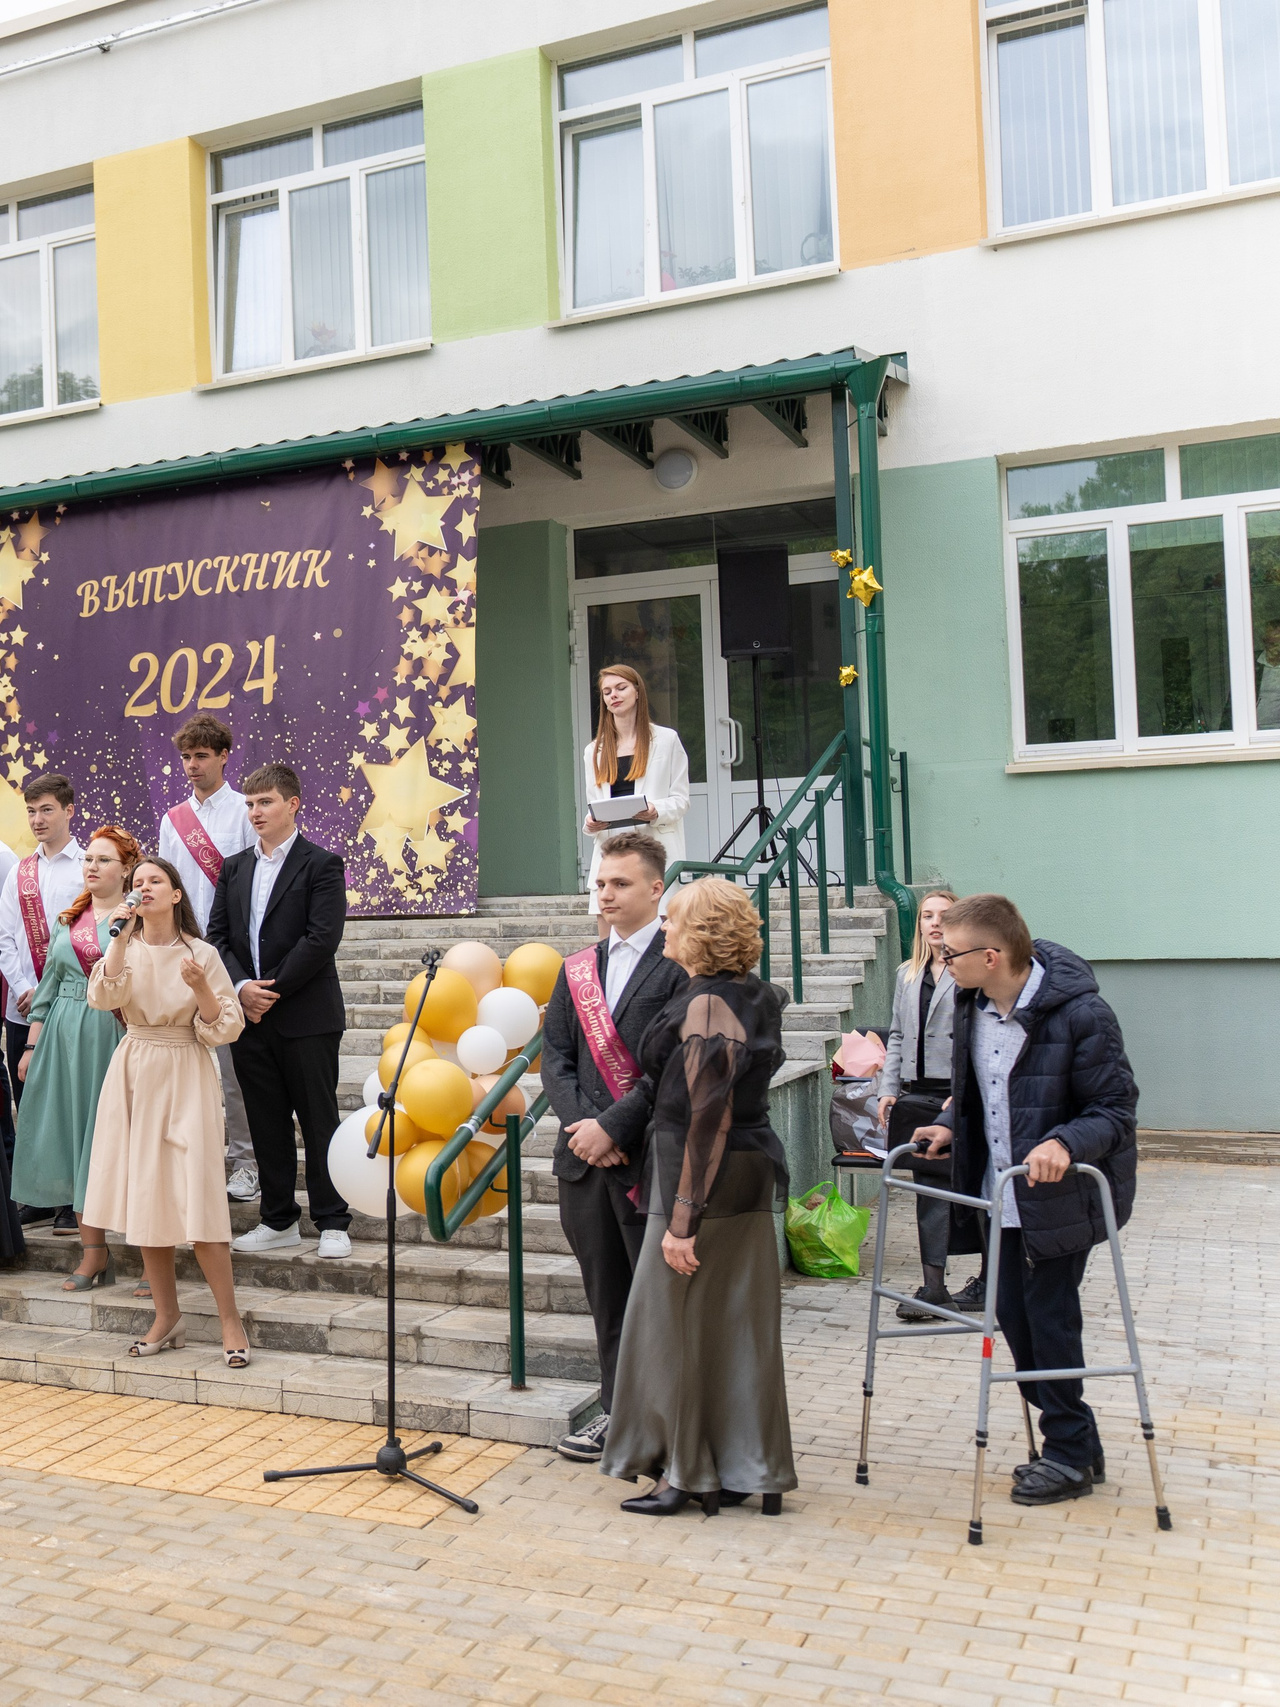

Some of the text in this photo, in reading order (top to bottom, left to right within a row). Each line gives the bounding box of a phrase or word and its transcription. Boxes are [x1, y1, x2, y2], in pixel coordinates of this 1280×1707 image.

[76, 549, 331, 617] ВЫПУСКНИК
[124, 634, 278, 717] 2024
[577, 981, 620, 1072] Выпускник
